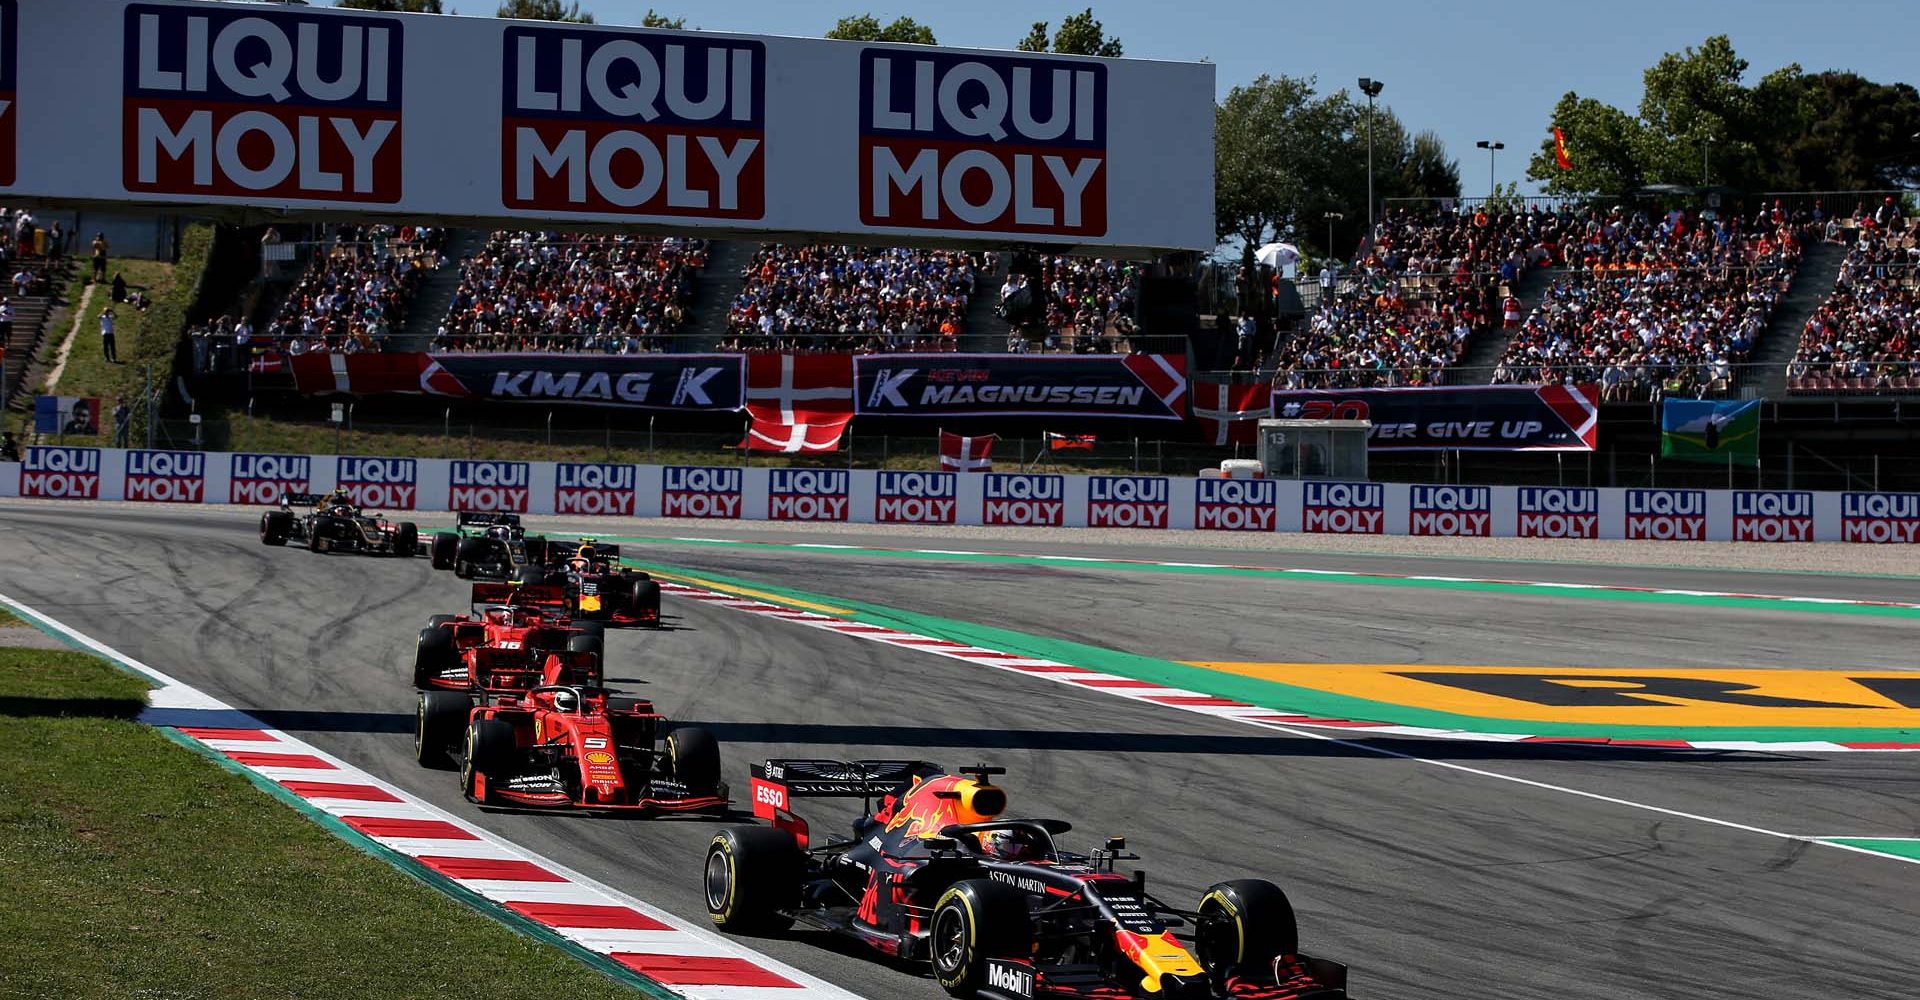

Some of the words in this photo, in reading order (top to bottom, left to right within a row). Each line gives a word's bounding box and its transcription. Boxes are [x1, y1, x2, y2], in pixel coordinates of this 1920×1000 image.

[138, 13, 389, 103] LIQUI
[516, 35, 753, 122] LIQUI
[872, 57, 1096, 142] LIQUI
[138, 107, 398, 194] MOLY
[516, 126, 761, 210] MOLY
[872, 145, 1103, 227] MOLY
[491, 370, 654, 402] KMAG
[671, 367, 724, 405] K
[927, 368, 990, 382] KEVIN
[866, 368, 920, 407] K
[920, 385, 1144, 405] MAGNUSSEN
[1282, 400, 1369, 420] #20
[1270, 433, 1286, 445] 13
[1426, 421, 1495, 438] GIVE
[1501, 421, 1542, 438] UP
[24, 449, 97, 472] LIQUI
[130, 453, 202, 476] LIQUI
[234, 456, 308, 479] LIQUI
[341, 459, 414, 482] LIQUI
[22, 474, 98, 497] MOLY
[454, 463, 526, 486] LIQUI
[560, 466, 633, 489] LIQUI
[666, 468, 739, 492] LIQUI
[773, 471, 846, 494] LIQUI
[880, 473, 953, 497] LIQUI
[127, 478, 203, 501] MOLY
[988, 476, 1061, 499] LIQUI
[1092, 479, 1166, 501] LIQUI
[1200, 481, 1273, 504] LIQUI
[1307, 484, 1381, 507] LIQUI
[1414, 488, 1487, 510] LIQUI
[452, 488, 527, 511] MOLY
[558, 491, 634, 513] MOLY
[665, 494, 741, 516] MOLY
[771, 496, 847, 518] MOLY
[879, 499, 955, 521] MOLY
[1522, 490, 1595, 512] LIQUI
[1630, 492, 1703, 514] LIQUI
[1737, 494, 1810, 516] LIQUI
[1845, 495, 1918, 518] LIQUI
[986, 502, 1063, 524] MOLY
[1091, 504, 1167, 527] MOLY
[1199, 507, 1275, 529] MOLY
[1306, 510, 1383, 533] MOLY
[1413, 513, 1489, 535] MOLY
[1521, 515, 1597, 537] MOLY
[1629, 517, 1705, 539] MOLY
[1736, 519, 1812, 541] MOLY
[1845, 520, 1920, 543] MOLY
[499, 640, 521, 650] 16
[583, 737, 608, 749] 5
[756, 785, 783, 808] ESSO
[988, 870, 1016, 888] ASTON
[1017, 877, 1046, 894] MARTIN
[988, 963, 1022, 994] Mobil
[1024, 973, 1033, 997] 1
